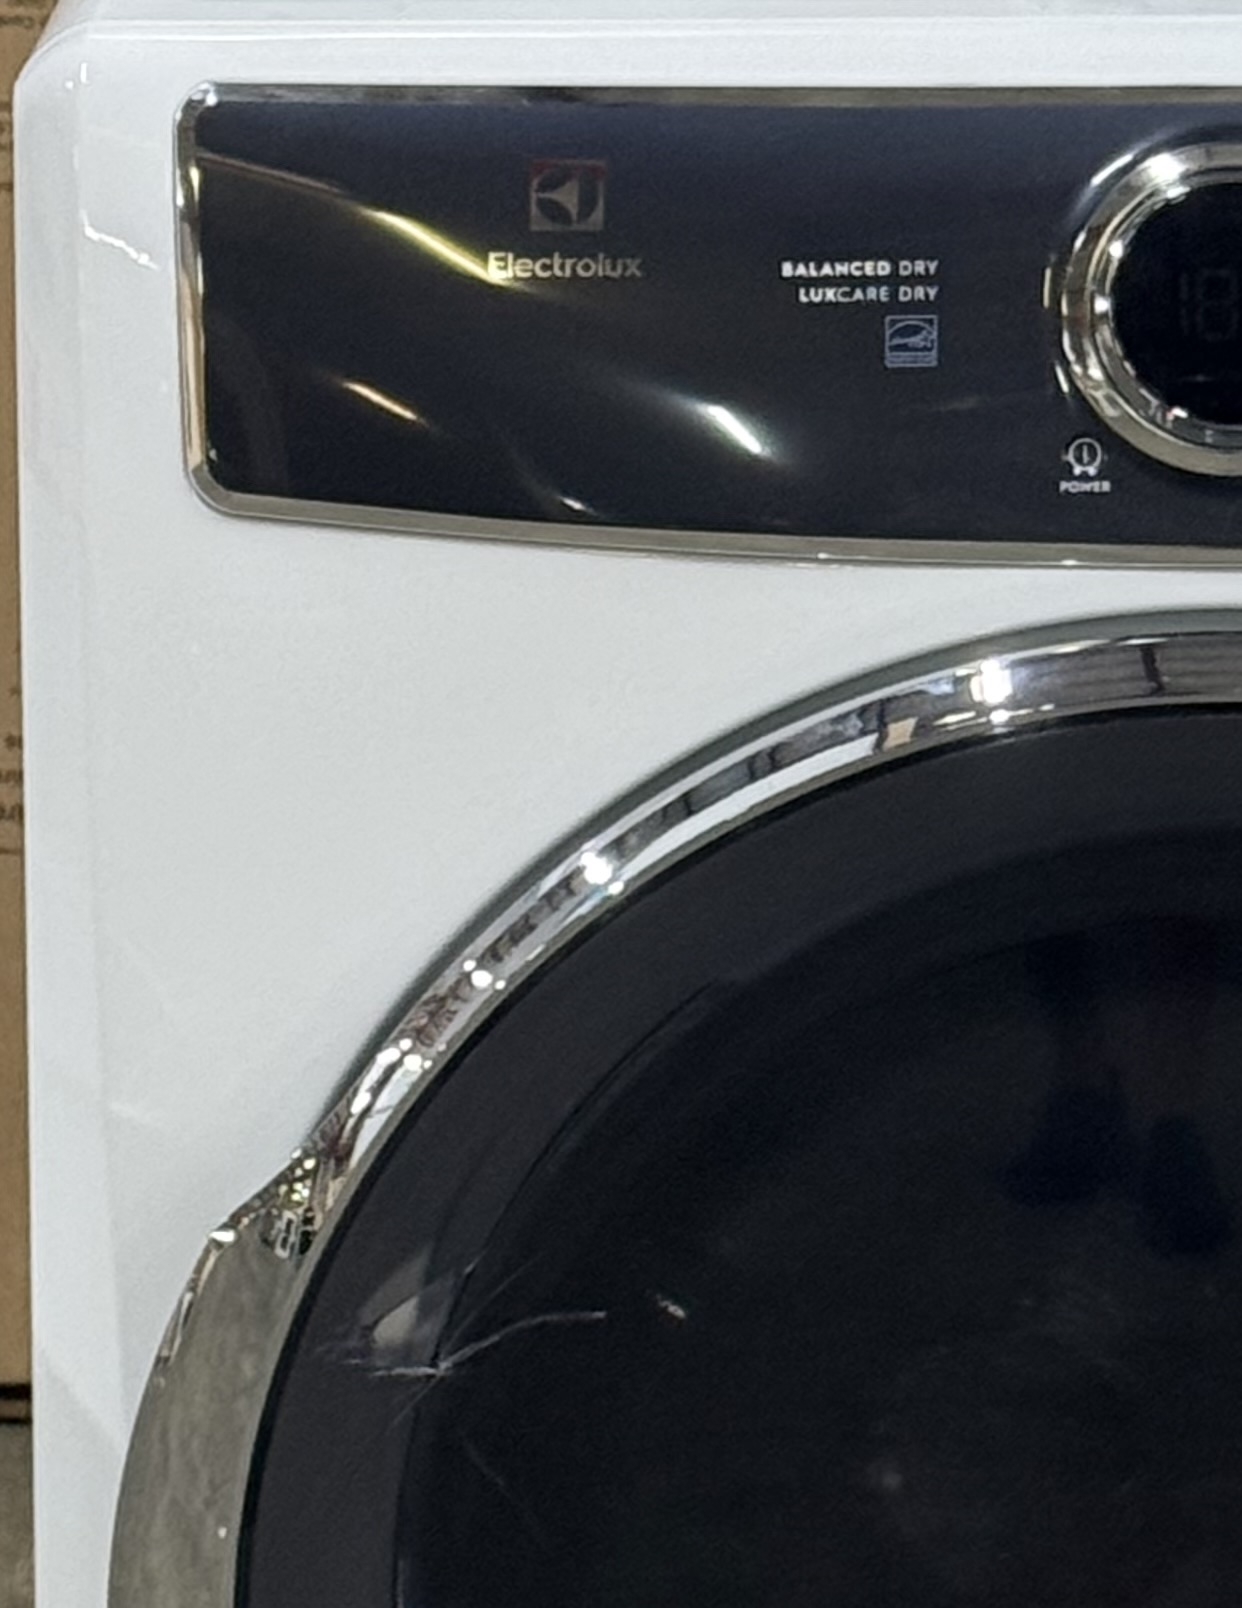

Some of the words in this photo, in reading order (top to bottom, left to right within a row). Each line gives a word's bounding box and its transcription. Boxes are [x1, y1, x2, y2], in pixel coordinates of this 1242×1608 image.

[487, 252, 643, 279] Electrolux
[781, 260, 892, 277] BALANCED
[899, 260, 939, 275] DRY
[799, 286, 890, 303] LUXCARE
[899, 285, 939, 302] DRY
[1059, 480, 1112, 494] POWER
